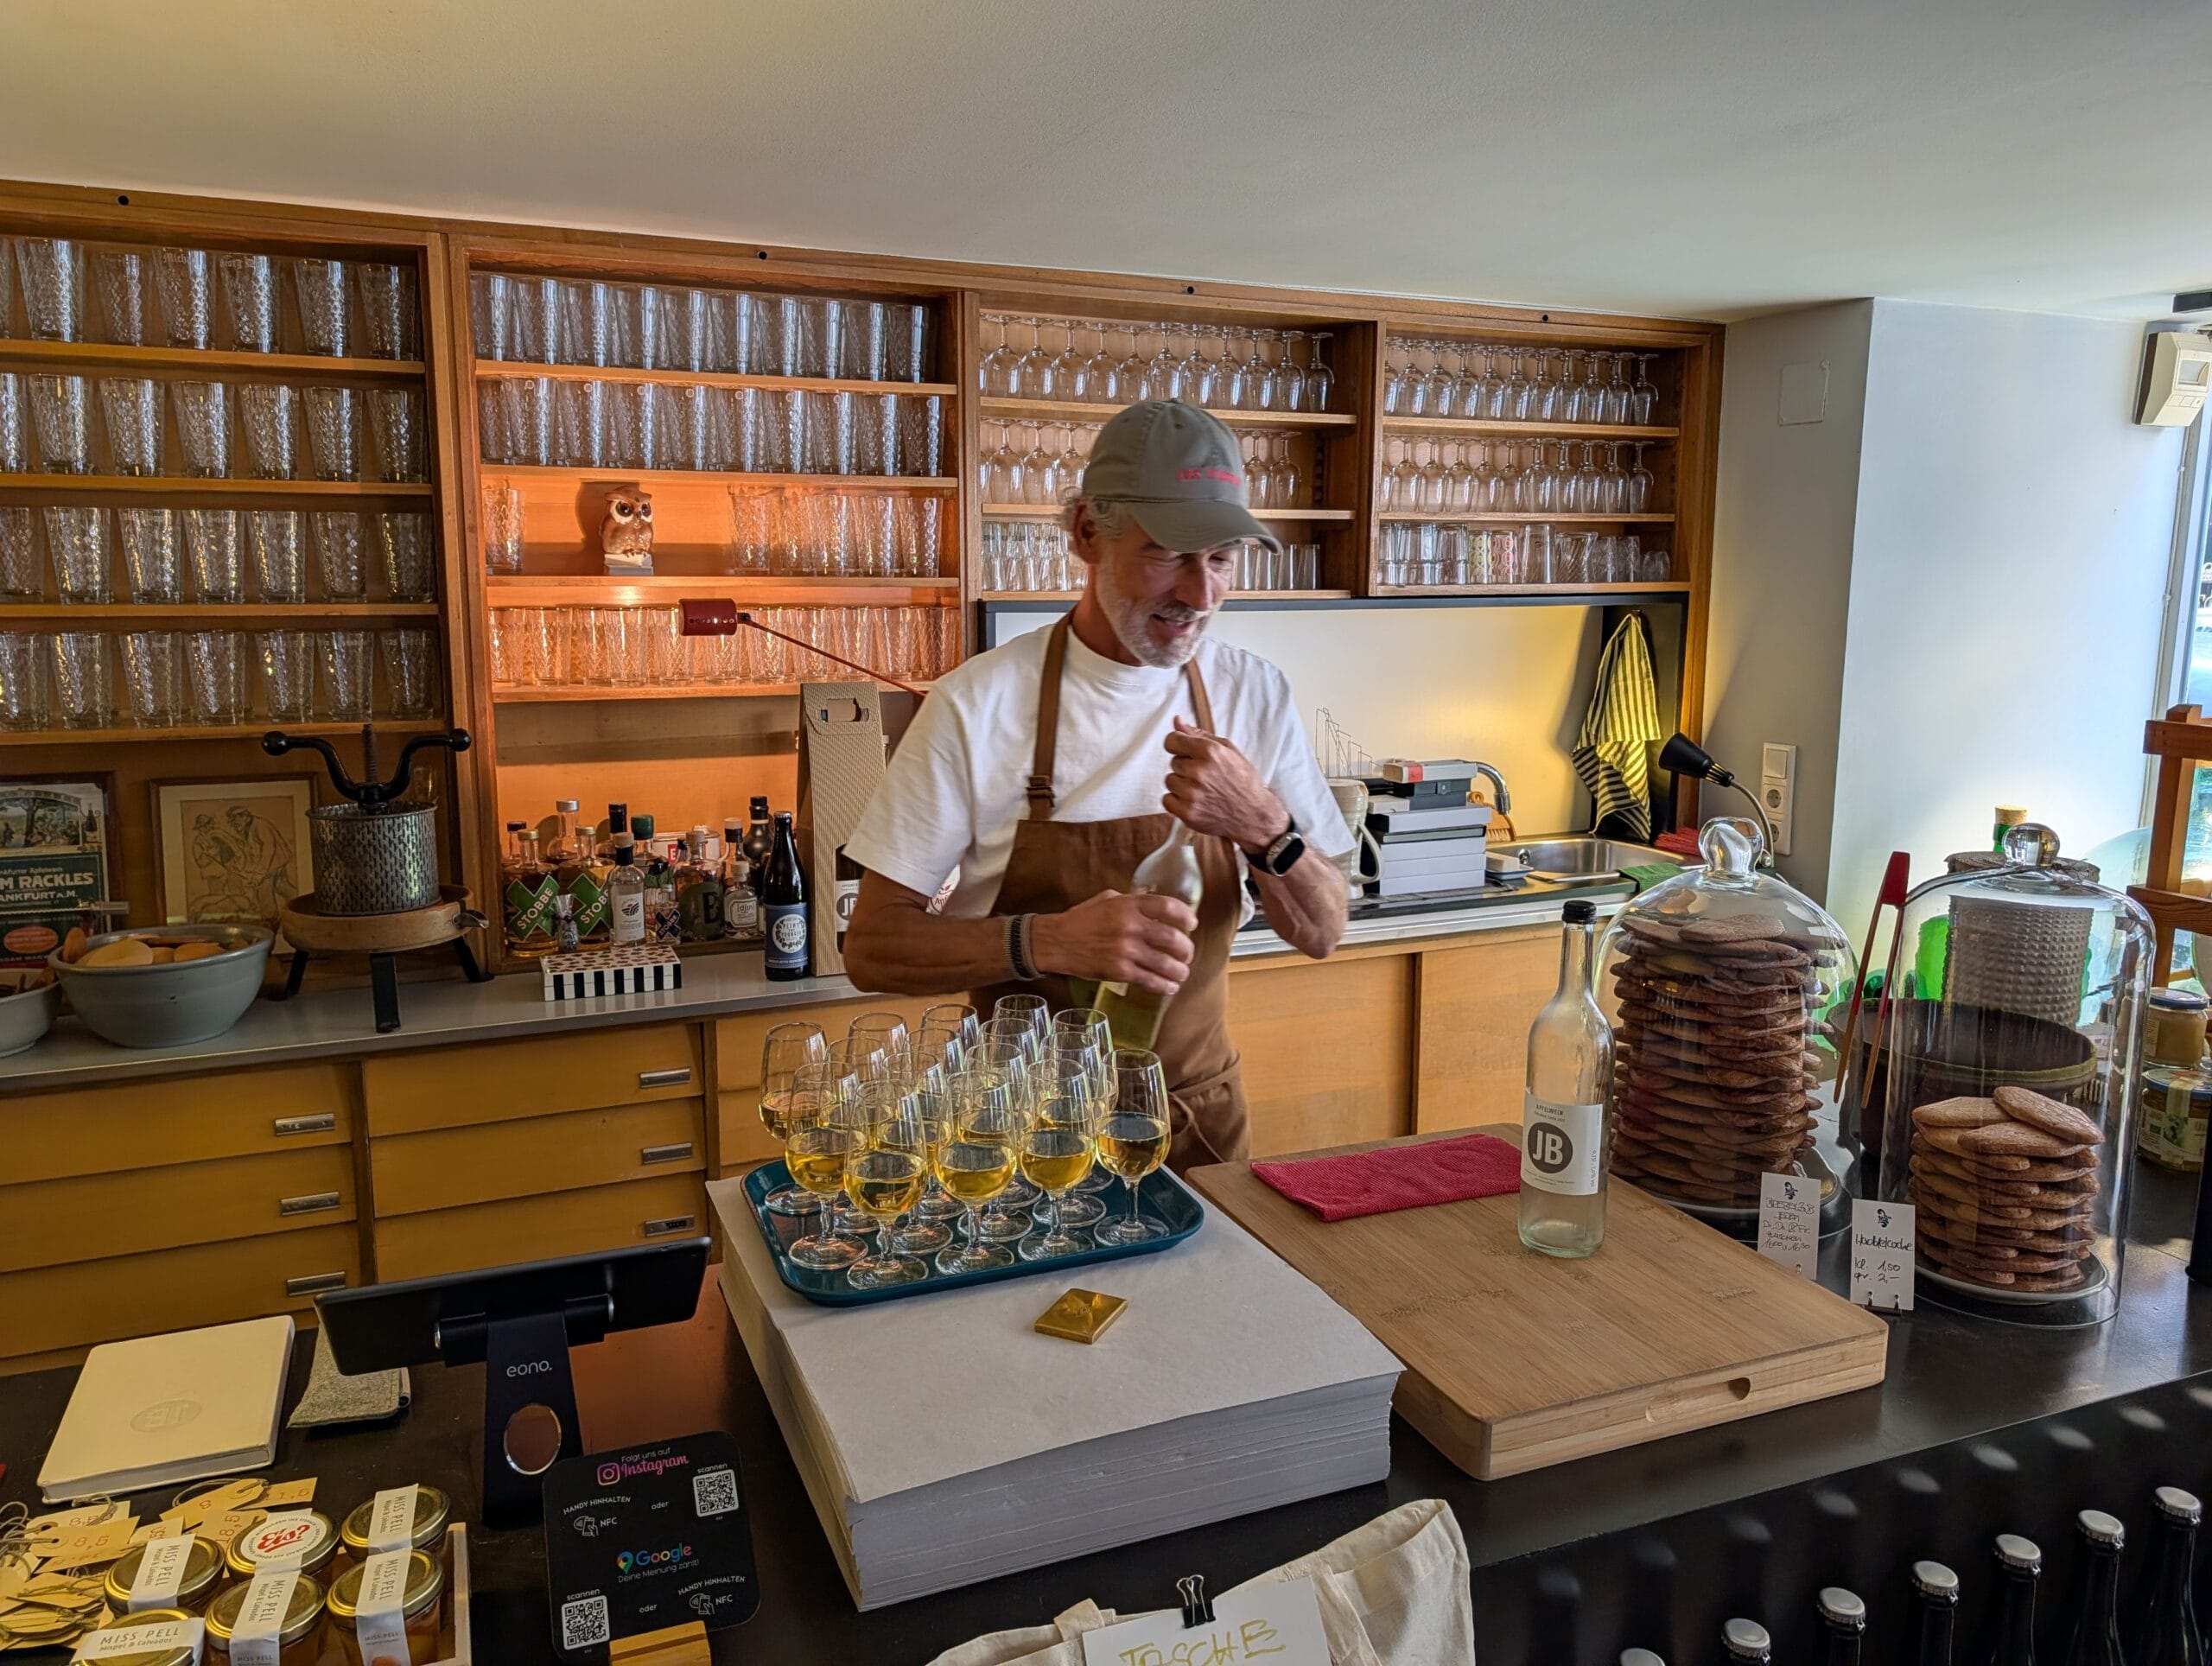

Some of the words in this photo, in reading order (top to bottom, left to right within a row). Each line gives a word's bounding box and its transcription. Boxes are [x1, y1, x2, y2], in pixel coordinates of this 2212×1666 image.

[18, 872, 94, 890] RACKLES
[517, 887, 554, 931] STOBBE
[658, 913, 678, 936] STOBBE
[1532, 1129, 1564, 1166] JB
[1877, 1260, 1901, 1273] 1,50
[621, 1454, 641, 1464] Folgt
[658, 1447, 671, 1456] auf
[620, 1454, 690, 1478] Instagram
[696, 1463, 728, 1474] scannen
[393, 1495, 407, 1515] MISS
[563, 1500, 589, 1516] HANDY
[588, 1496, 632, 1507] HINHALTEN
[651, 1500, 670, 1510] oder
[389, 1514, 404, 1533] PELL
[600, 1517, 619, 1528] NFC
[164, 1544, 181, 1565] MISS
[635, 1542, 692, 1566] Google
[155, 1566, 172, 1587] PELL
[384, 1558, 399, 1580] MISS
[618, 1572, 641, 1584] Deine
[642, 1564, 677, 1579] Meinung
[267, 1580, 286, 1599] MISS
[378, 1580, 394, 1601] PELL
[566, 1587, 601, 1601] scannen
[677, 1580, 703, 1597] HANDY
[703, 1574, 746, 1587] HINHALTEN
[639, 1603, 658, 1614] oder
[715, 1593, 734, 1606] NFC
[258, 1601, 277, 1623] PELL
[99, 1631, 137, 1645] MISS
[146, 1627, 180, 1638] PELL
